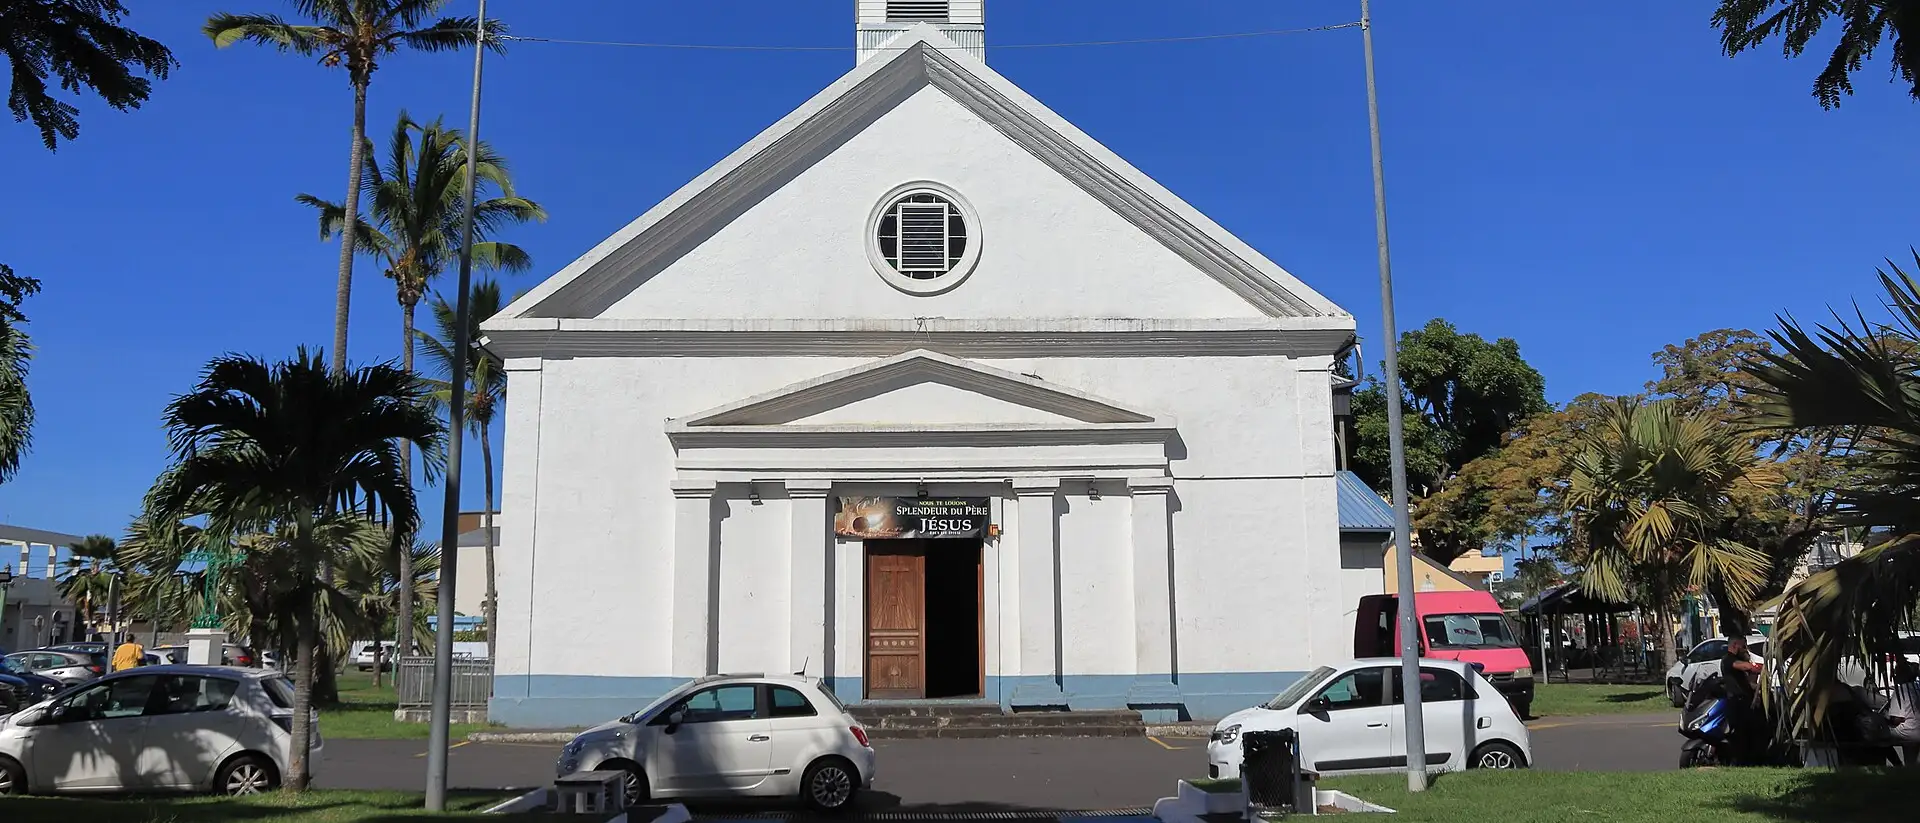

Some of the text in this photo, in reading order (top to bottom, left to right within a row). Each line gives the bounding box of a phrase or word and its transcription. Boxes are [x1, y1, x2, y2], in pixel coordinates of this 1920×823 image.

[896, 505, 948, 515] SPLENDEUR
[965, 505, 988, 515] PÈRE
[919, 516, 972, 533] JÉSUS
